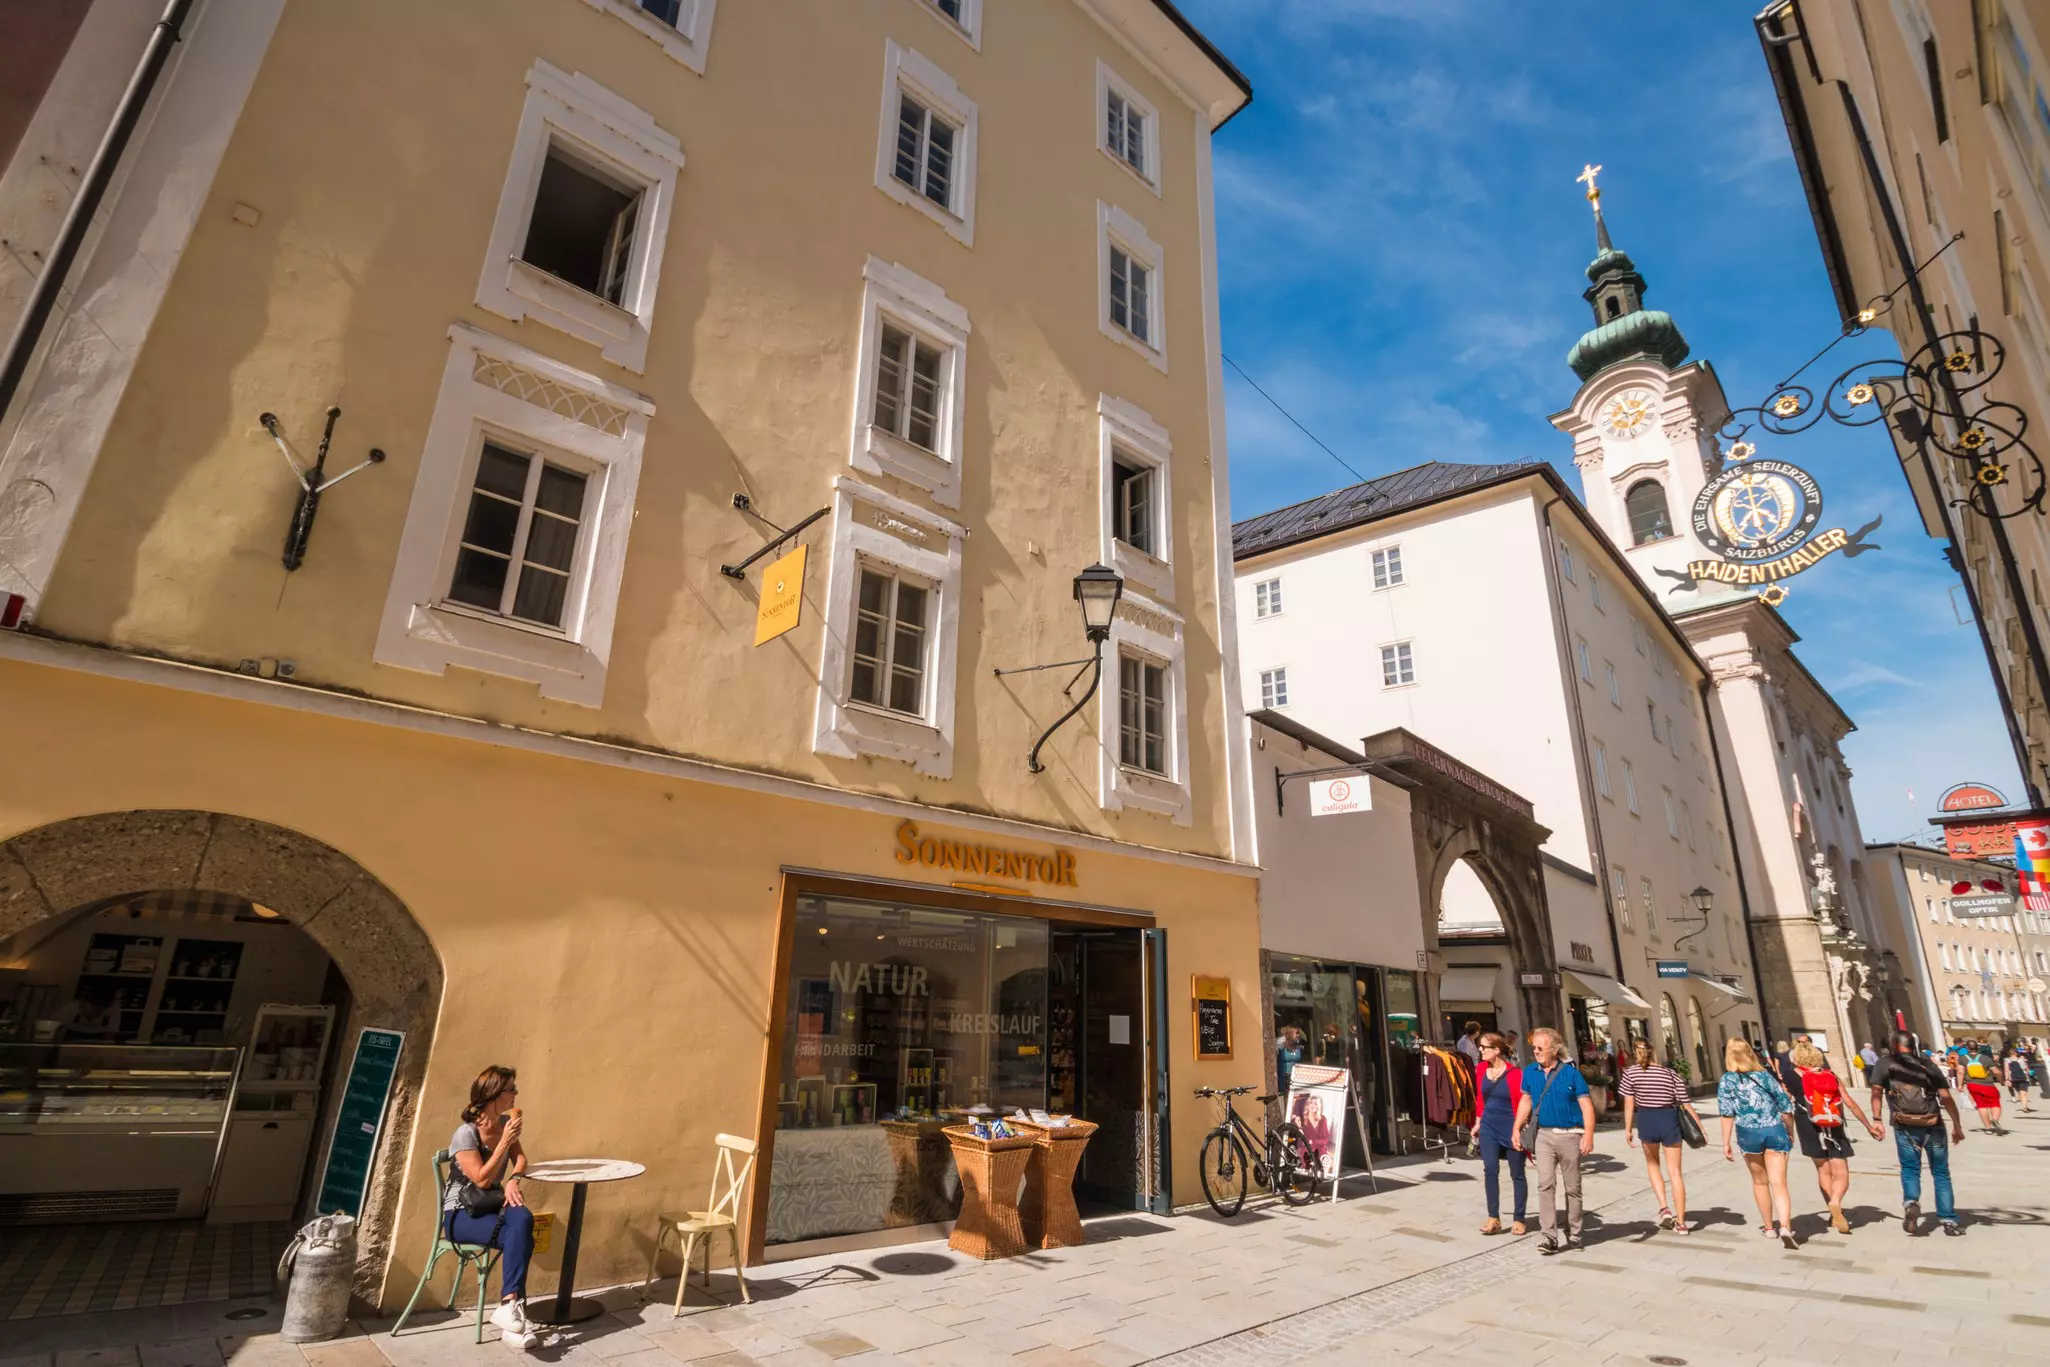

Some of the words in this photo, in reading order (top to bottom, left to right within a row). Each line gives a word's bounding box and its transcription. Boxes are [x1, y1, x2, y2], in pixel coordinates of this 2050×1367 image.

[1695, 466, 1744, 511] EHRSAME
[1752, 461, 1821, 505] SEILERZUNFT
[1694, 513, 1707, 532] DIE
[1688, 528, 1849, 584] HAIDENTHALLER
[1723, 528, 1807, 559] SALZBURGS
[1413, 743, 1479, 789] FEUERWACHE
[1321, 801, 1359, 812] caligula
[1947, 794, 1991, 808] HOTEL
[895, 818, 1079, 888] SONNENTOR
[1952, 897, 2012, 908] GOLLHOFER
[1968, 906, 1999, 914] OPTIK
[897, 935, 976, 953] WERTSCHÄTZUNG
[829, 960, 930, 997] NATUR
[949, 1012, 1041, 1035] KREISLAUF
